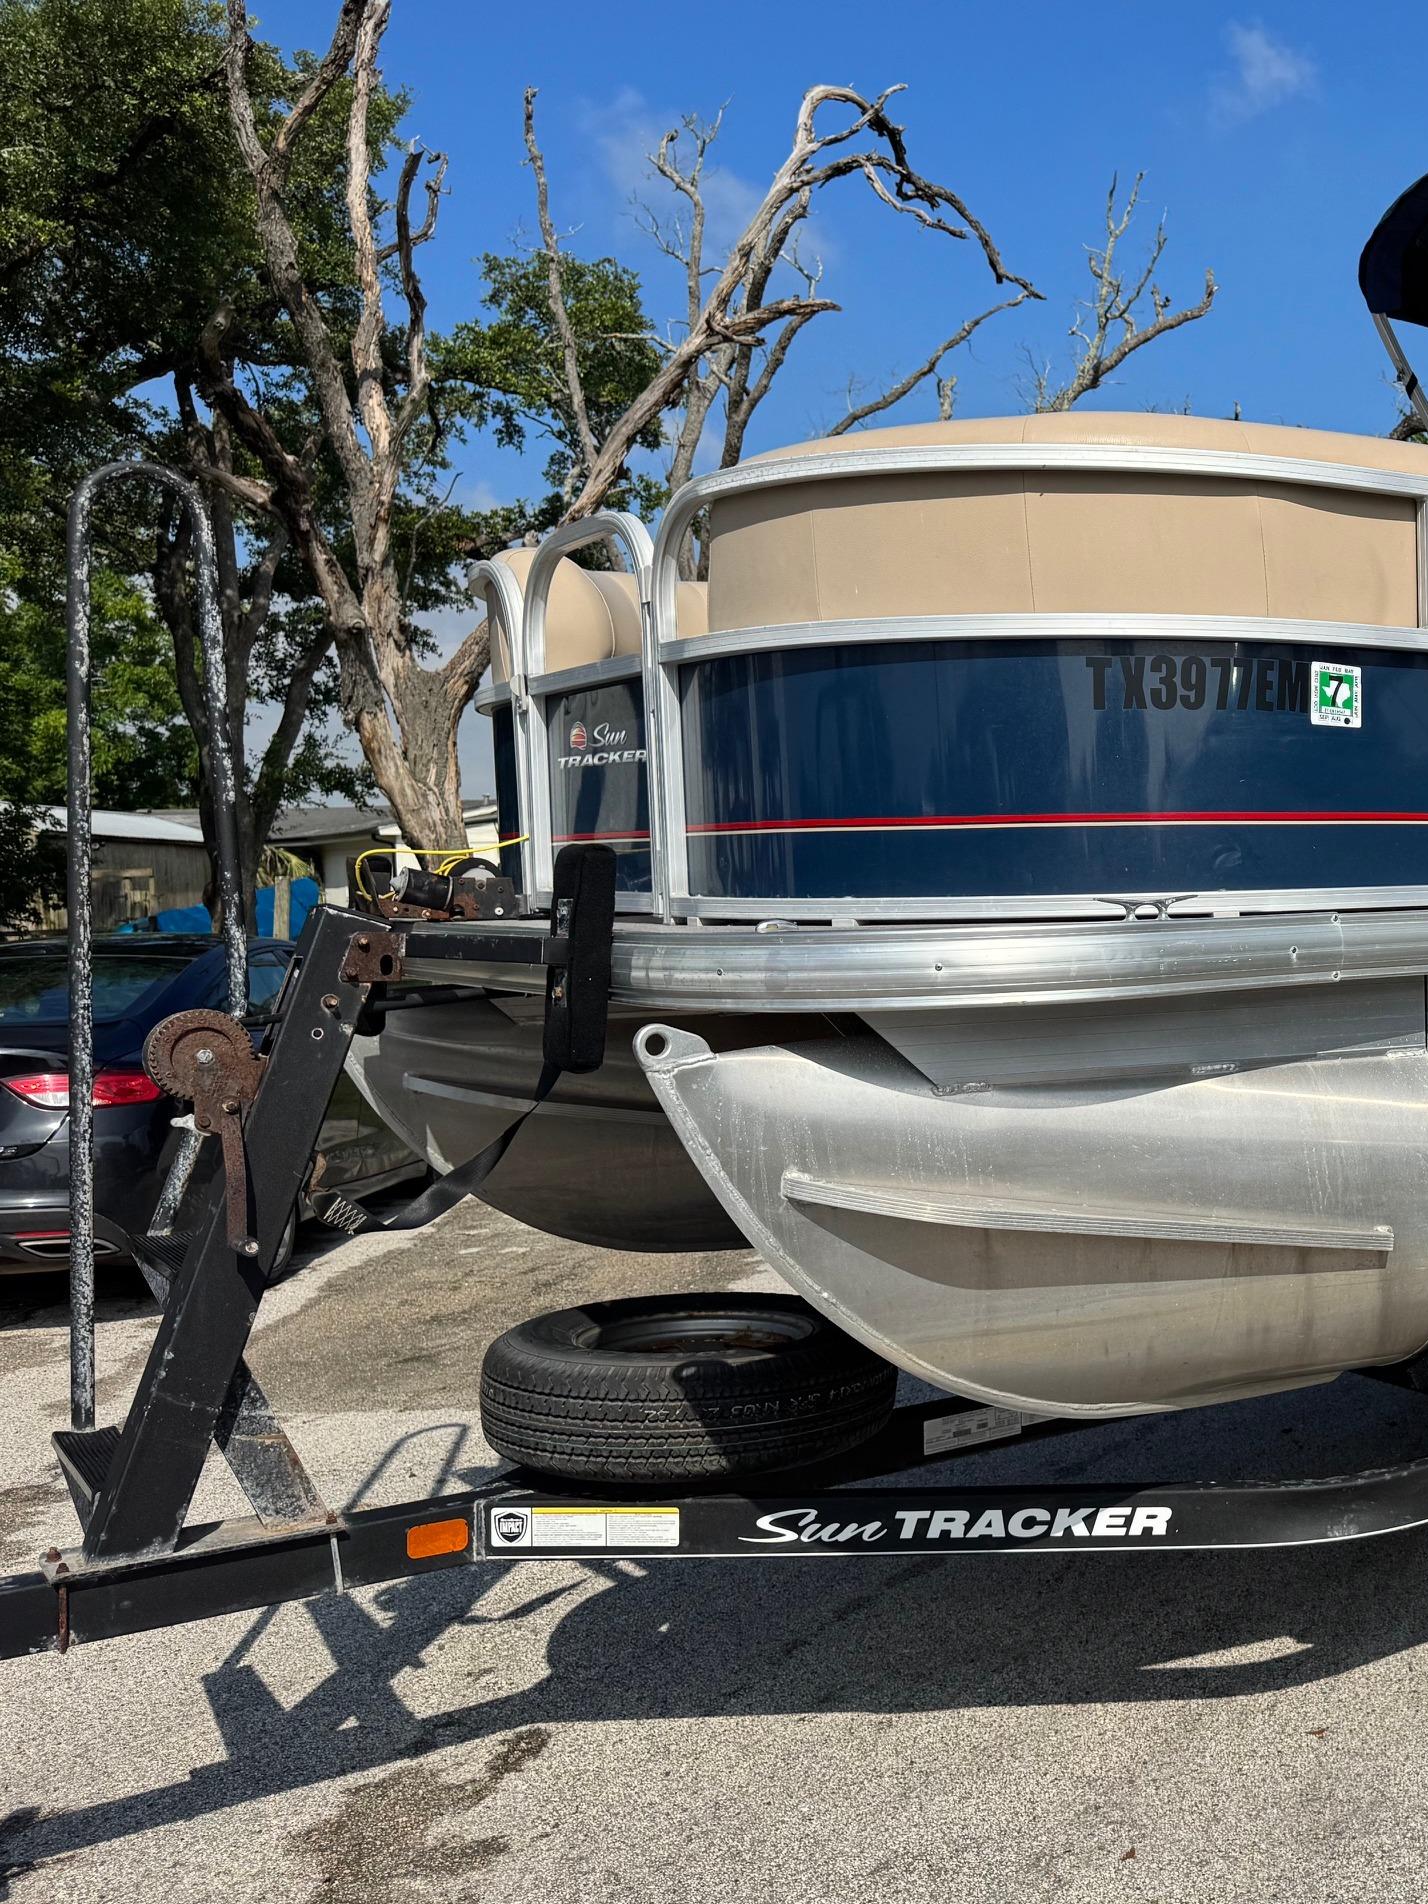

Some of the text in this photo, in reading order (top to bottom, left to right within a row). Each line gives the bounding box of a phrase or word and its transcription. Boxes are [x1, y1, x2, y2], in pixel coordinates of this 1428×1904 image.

[1085, 654, 1310, 713] TX3977EM
[1328, 675, 1344, 707] 7
[589, 721, 628, 748] Sun
[557, 750, 648, 769] TRACKER
[738, 1506, 1172, 1543] Sun TRACKER
